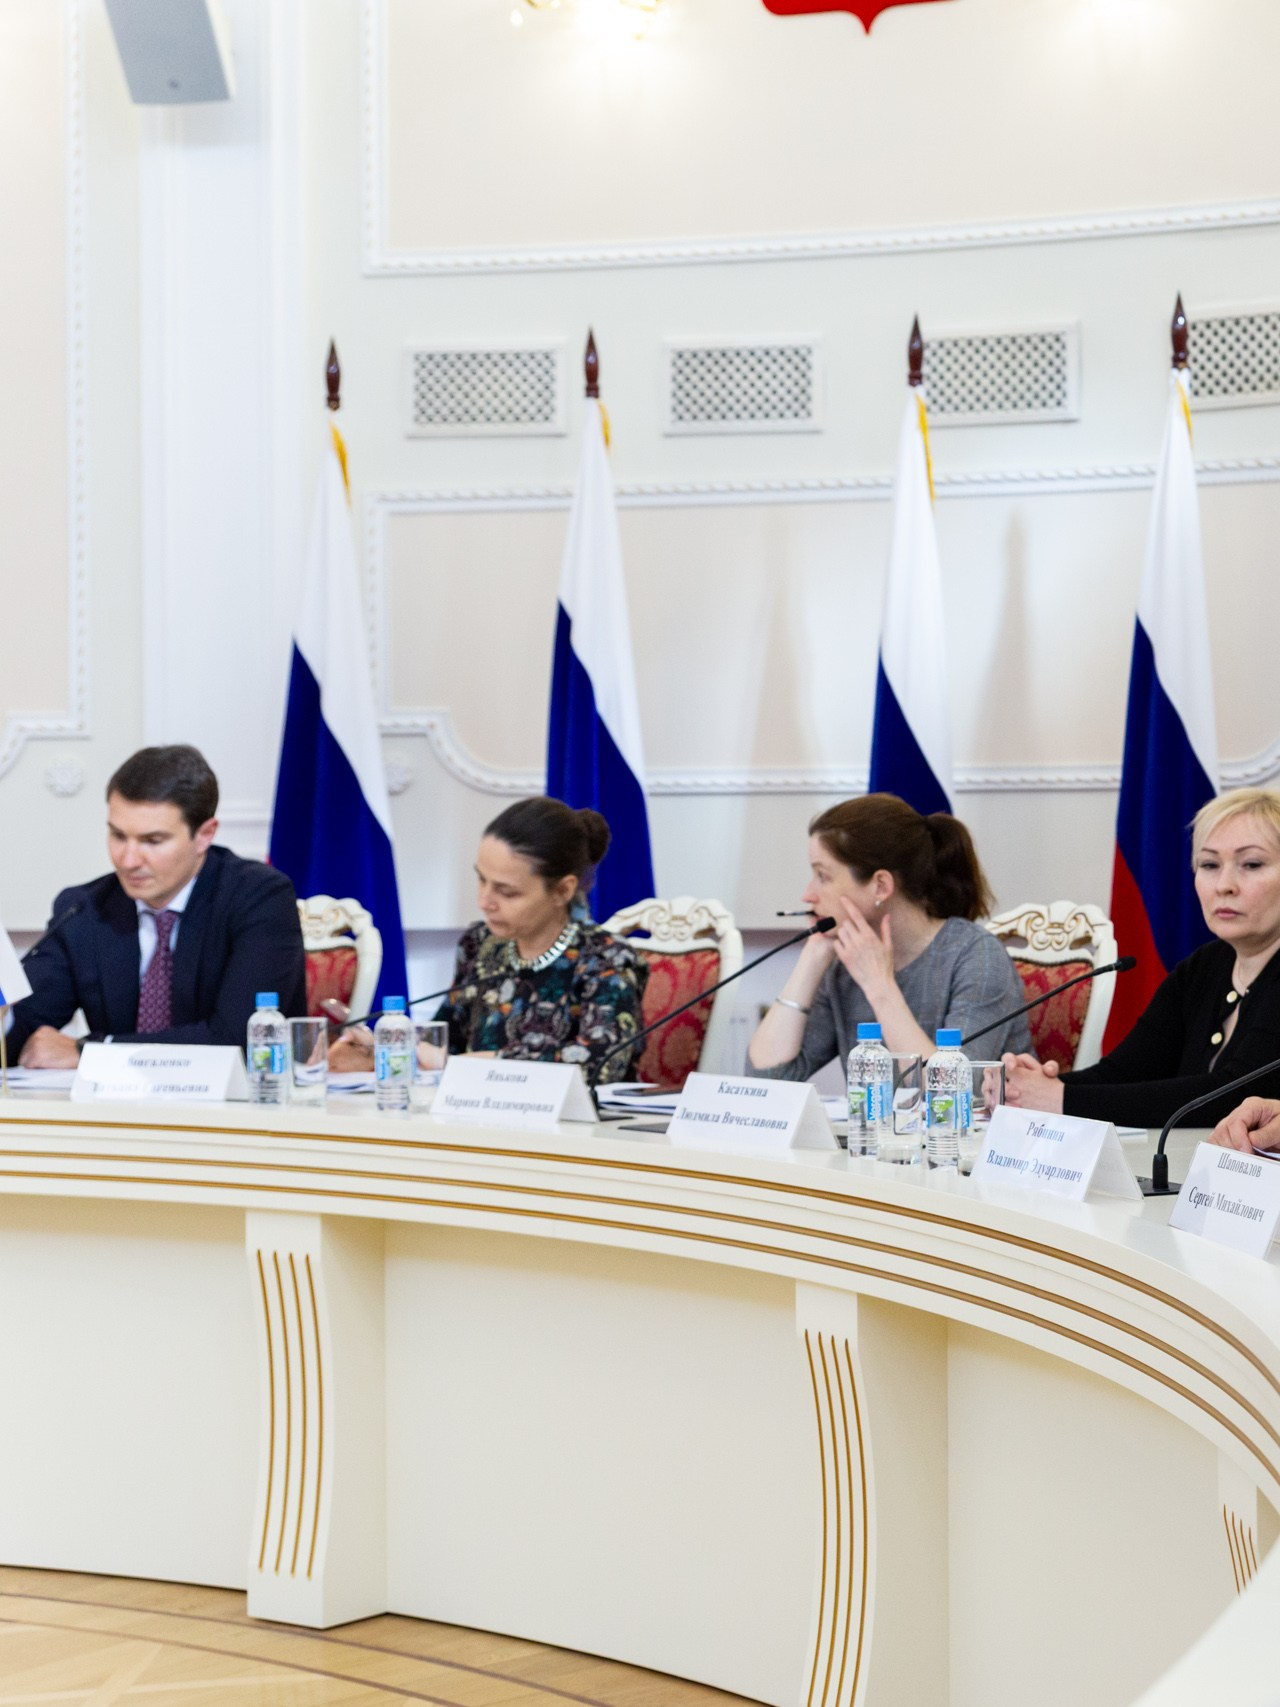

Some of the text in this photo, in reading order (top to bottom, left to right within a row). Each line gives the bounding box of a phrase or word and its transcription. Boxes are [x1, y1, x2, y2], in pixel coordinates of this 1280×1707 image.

[717, 1081, 768, 1098] Касаткина
[677, 1107, 789, 1130] Людмила Вячеславовна
[1026, 1121, 1065, 1143] Рябинин
[986, 1149, 1083, 1182] Владимир Эдуардович
[1217, 1152, 1263, 1178] Шаповалов
[1188, 1186, 1265, 1222] Сергей Михайлович
